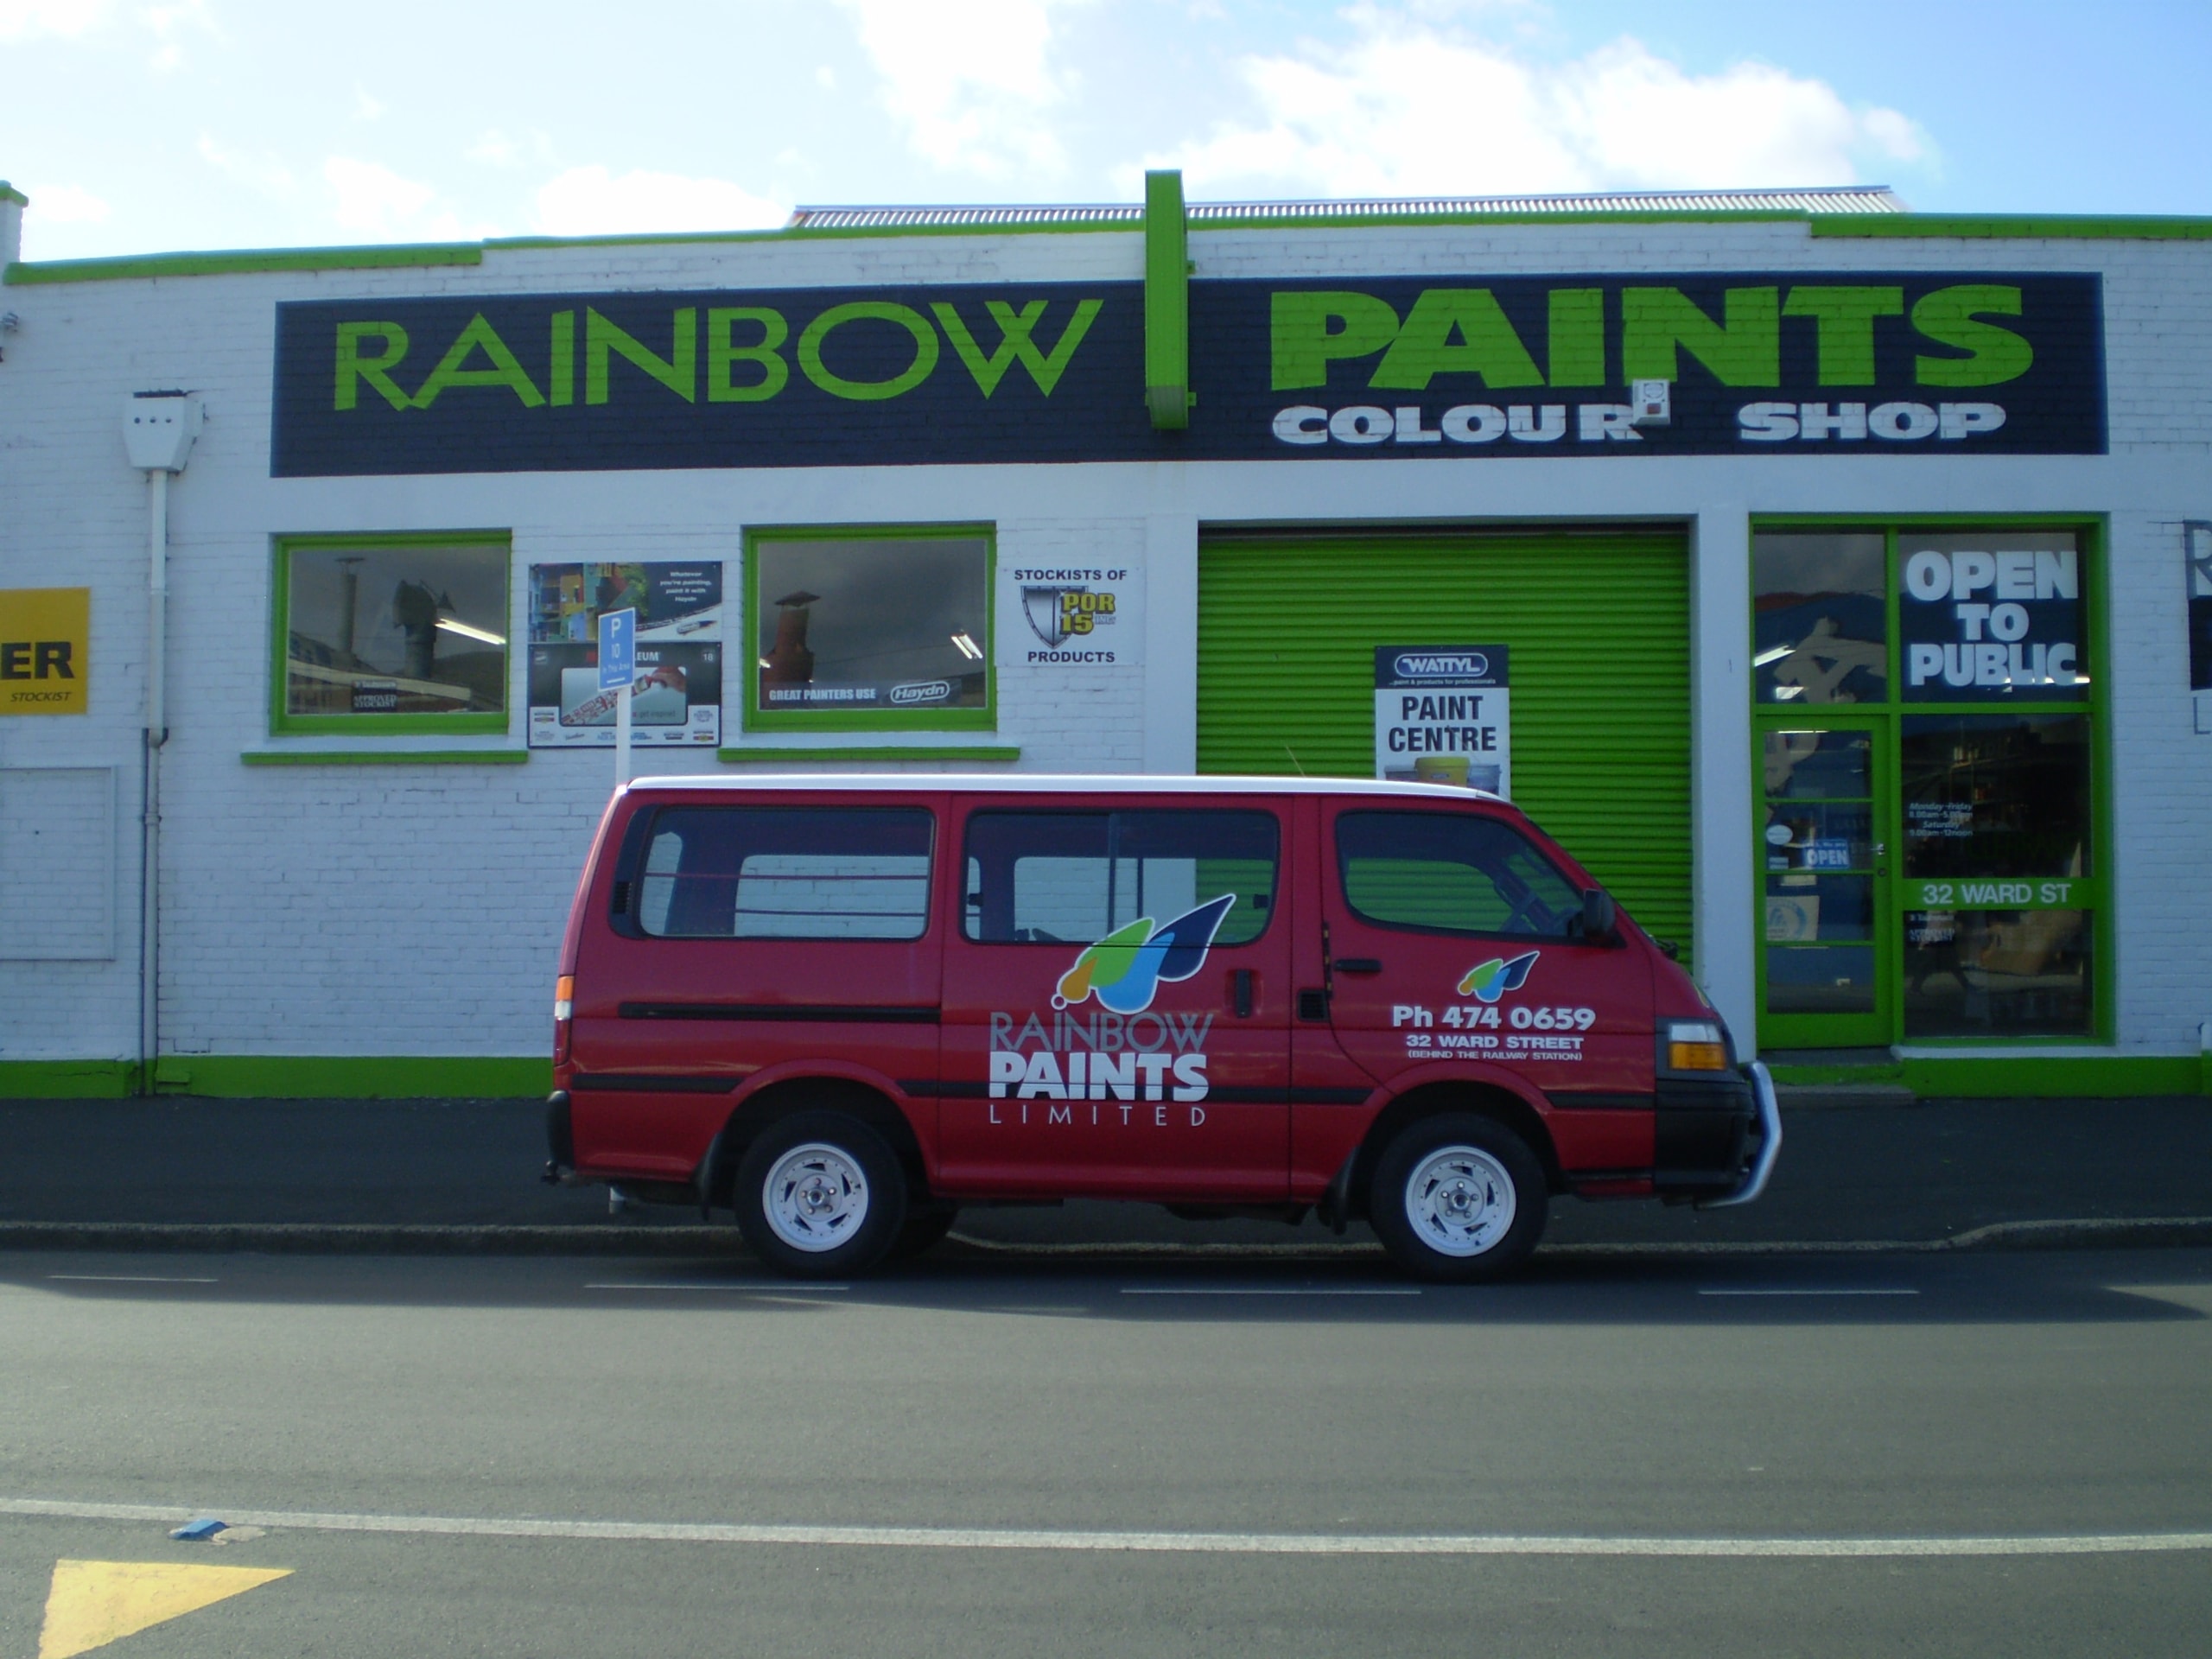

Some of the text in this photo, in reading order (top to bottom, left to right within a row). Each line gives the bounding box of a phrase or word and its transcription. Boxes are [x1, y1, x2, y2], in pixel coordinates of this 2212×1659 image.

[334, 284, 2034, 411] RAINBOW PAINTS
[1272, 402, 2006, 444] COLOUR SHOP
[1014, 569, 1128, 581] STOCKISTS OF
[1906, 550, 2079, 601] OPEN
[1060, 592, 1116, 614] POR
[611, 617, 621, 639] P
[1059, 613, 1095, 636] 15
[1957, 603, 2030, 641] TO
[0, 641, 75, 680] ER
[611, 643, 621, 659] 10
[1027, 652, 1116, 663] PRODUCTS
[1402, 658, 1481, 672] WATTYL
[1910, 642, 2077, 687] PUBLIC
[10, 691, 72, 702] STOCKIST
[769, 689, 876, 701] GREAT PAINTERS USE
[893, 683, 944, 702] Haydn
[1402, 696, 1484, 721] PAINT
[1389, 727, 1497, 752] CENTRE
[1923, 821, 1961, 830] Saturday
[1807, 849, 1848, 865] OPEN
[1923, 883, 2072, 905] 32 WARD ST
[1393, 1006, 1596, 1030] Ph 474 0659
[989, 1011, 1214, 1053] RAINBOW
[1406, 1035, 1584, 1049] 32 WARD STREET
[1408, 1050, 1582, 1061] (BEHIND THE RAILWAY STATION)
[988, 1051, 1210, 1102] PAINTS
[989, 1103, 1206, 1127] LIMITED
